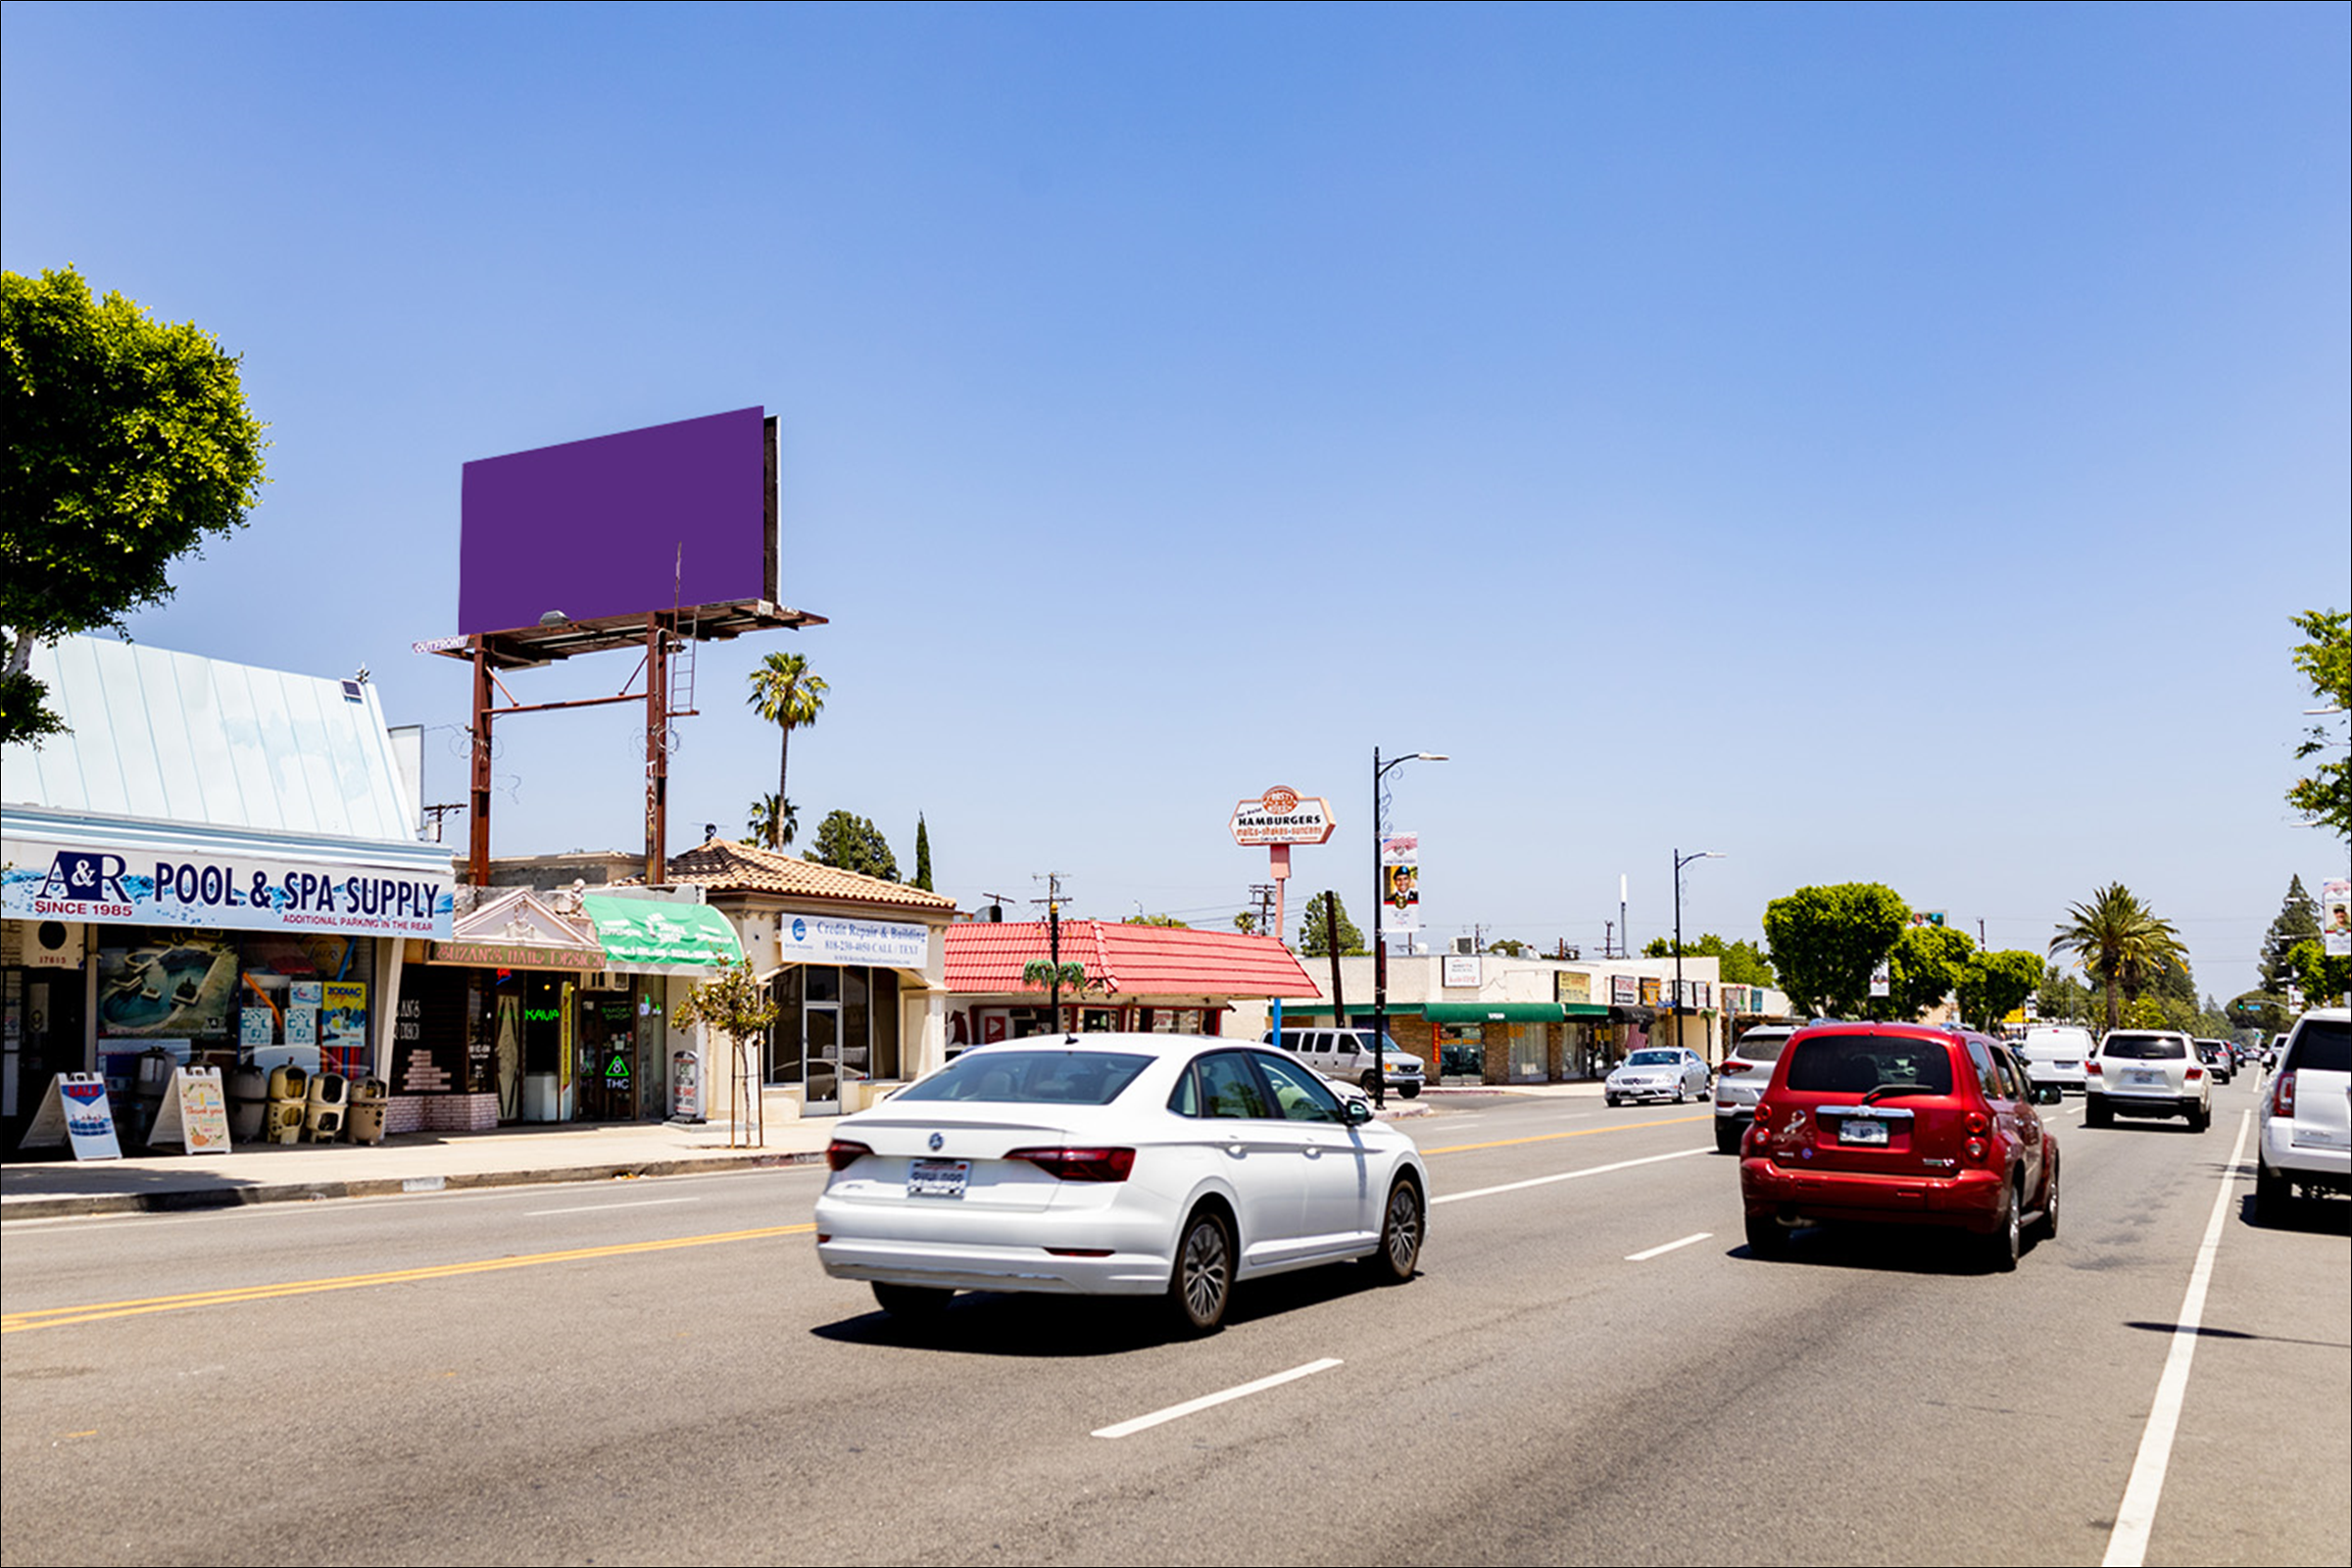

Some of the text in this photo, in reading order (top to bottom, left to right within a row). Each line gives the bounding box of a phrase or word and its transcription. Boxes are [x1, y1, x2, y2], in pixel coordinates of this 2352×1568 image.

[1238, 814, 1321, 826] HAMBURGERS
[35, 851, 132, 904] A&R
[155, 862, 439, 919] POOL & SPA SUPPLY
[34, 900, 133, 917] SINCE 1985
[282, 914, 433, 931] ADDITIONAL PARKING IN THE REAR
[849, 923, 878, 940] Repair
[891, 927, 926, 943] Building
[437, 943, 503, 963] SUZAN'S
[507, 948, 545, 965] HAIR
[550, 951, 606, 968] DESIGN
[68, 1085, 100, 1098] SALE
[606, 1078, 629, 1090] THC
